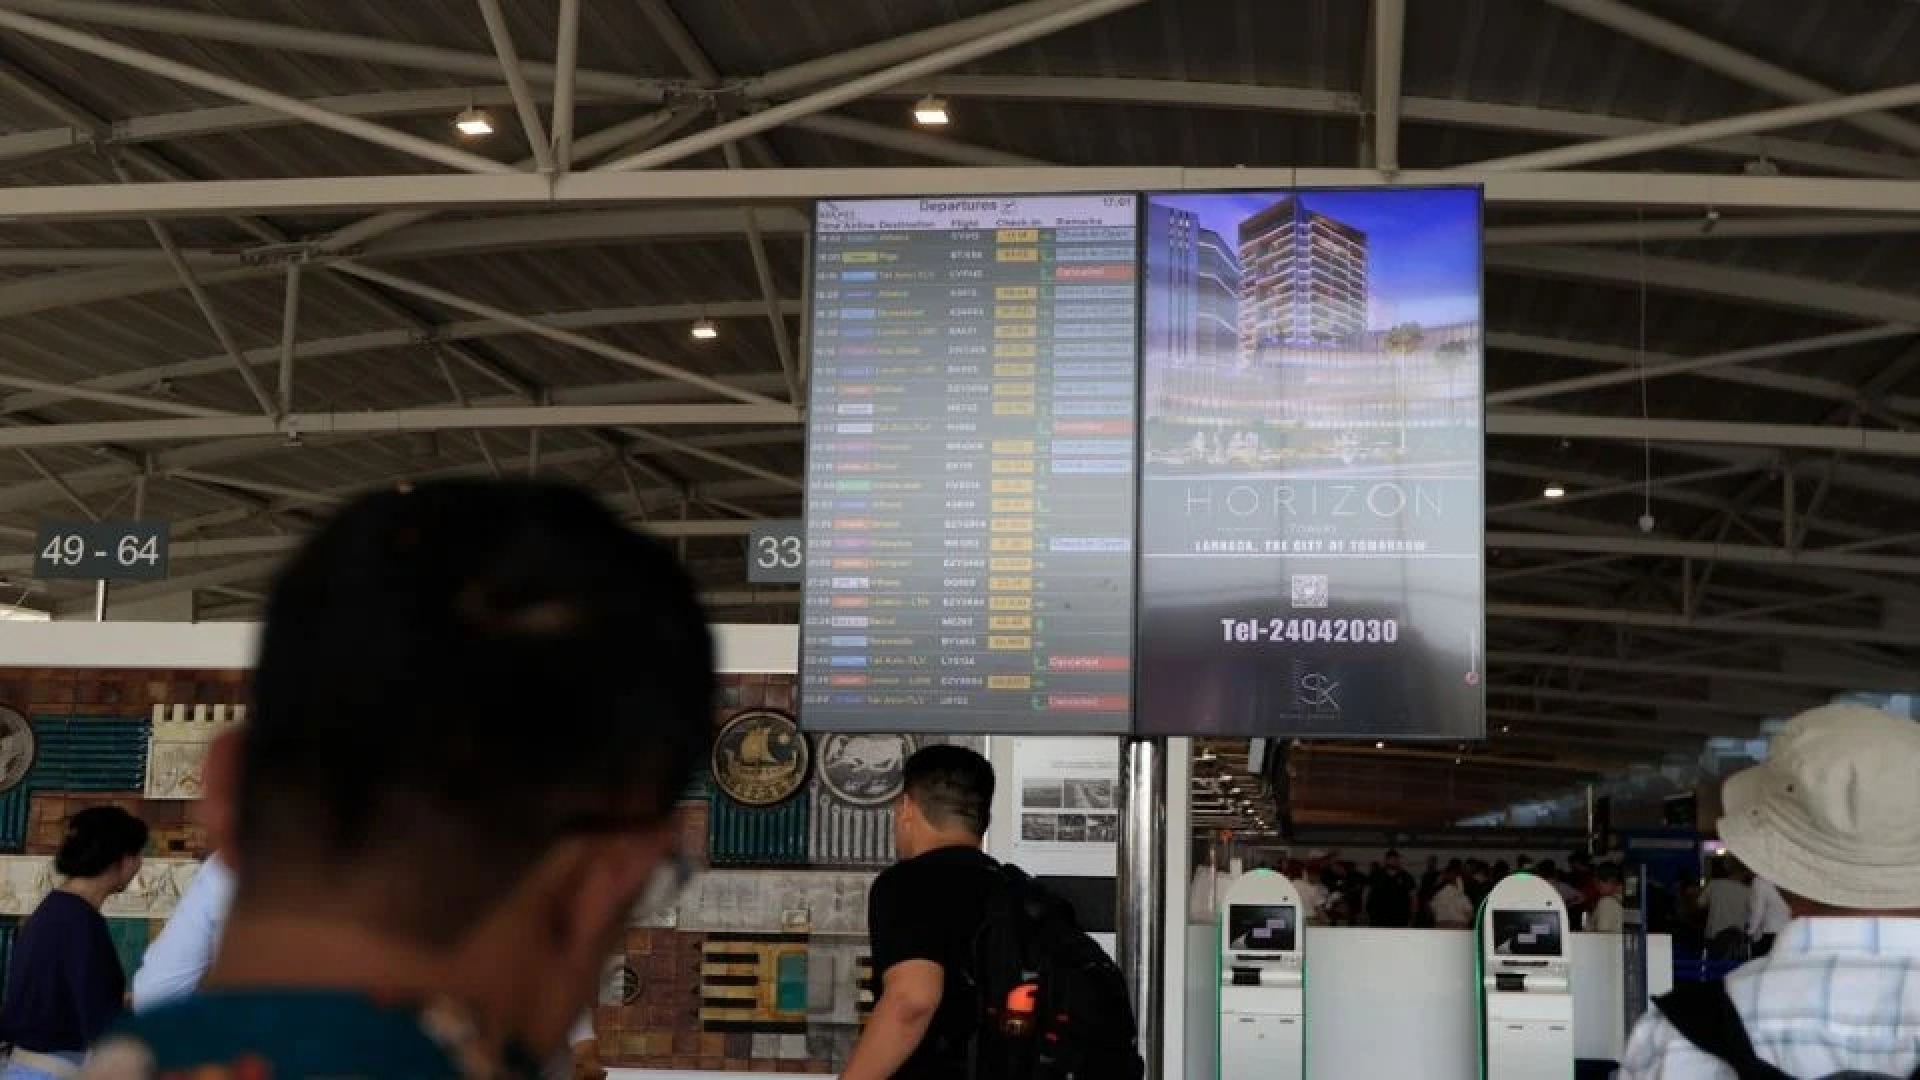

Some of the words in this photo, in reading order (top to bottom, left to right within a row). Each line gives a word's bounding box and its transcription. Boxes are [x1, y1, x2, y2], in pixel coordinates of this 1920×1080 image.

[920, 199, 997, 213] Departures
[1056, 216, 1103, 225] Remarks
[1184, 481, 1443, 517] HORIZON
[41, 533, 85, 566] 49
[117, 533, 160, 566] 64
[757, 535, 803, 569] 33
[1293, 540, 1323, 552] CITY
[1350, 539, 1427, 552] TOMORROW
[1220, 617, 1400, 642] Tel-24042030
